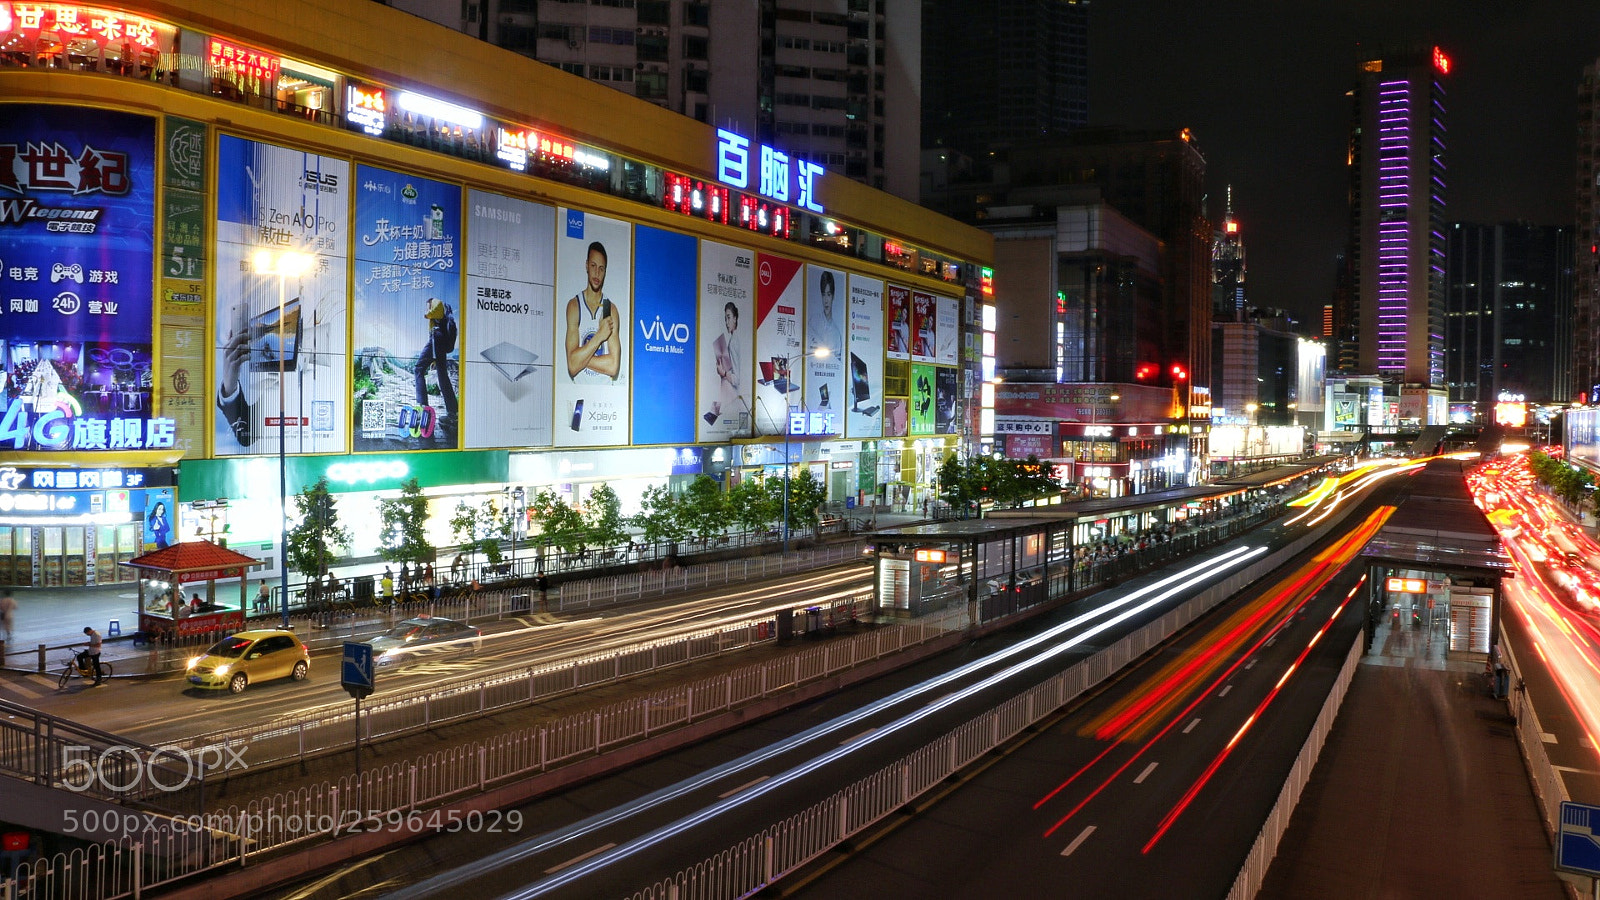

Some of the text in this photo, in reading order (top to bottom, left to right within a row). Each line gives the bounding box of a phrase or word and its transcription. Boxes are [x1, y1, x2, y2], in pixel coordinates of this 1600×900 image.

[210, 56, 271, 79] KESMIDO
[717, 128, 824, 213] 百脑汇
[27, 206, 100, 220] Legend
[269, 208, 336, 233] Zen AO Pro
[474, 204, 521, 224] SAMSUNG
[47, 221, 96, 234] 電子競技
[364, 217, 424, 246] 来杯牛奶
[9, 267, 118, 284] 电竞 游戏
[478, 261, 508, 278] 更简约
[381, 275, 434, 293] 大家一起来
[476, 286, 512, 300] 三星笔记本
[10, 299, 118, 315] 网咖 营业
[52, 297, 75, 309] 24h
[477, 298, 522, 315] Notebook
[523, 303, 529, 315] 9
[640, 315, 690, 343] vivo
[777, 315, 796, 337] 戴尔
[645, 343, 684, 354] Camera & Music
[72, 417, 175, 449] 旗舰店
[126, 474, 143, 486] 3F
